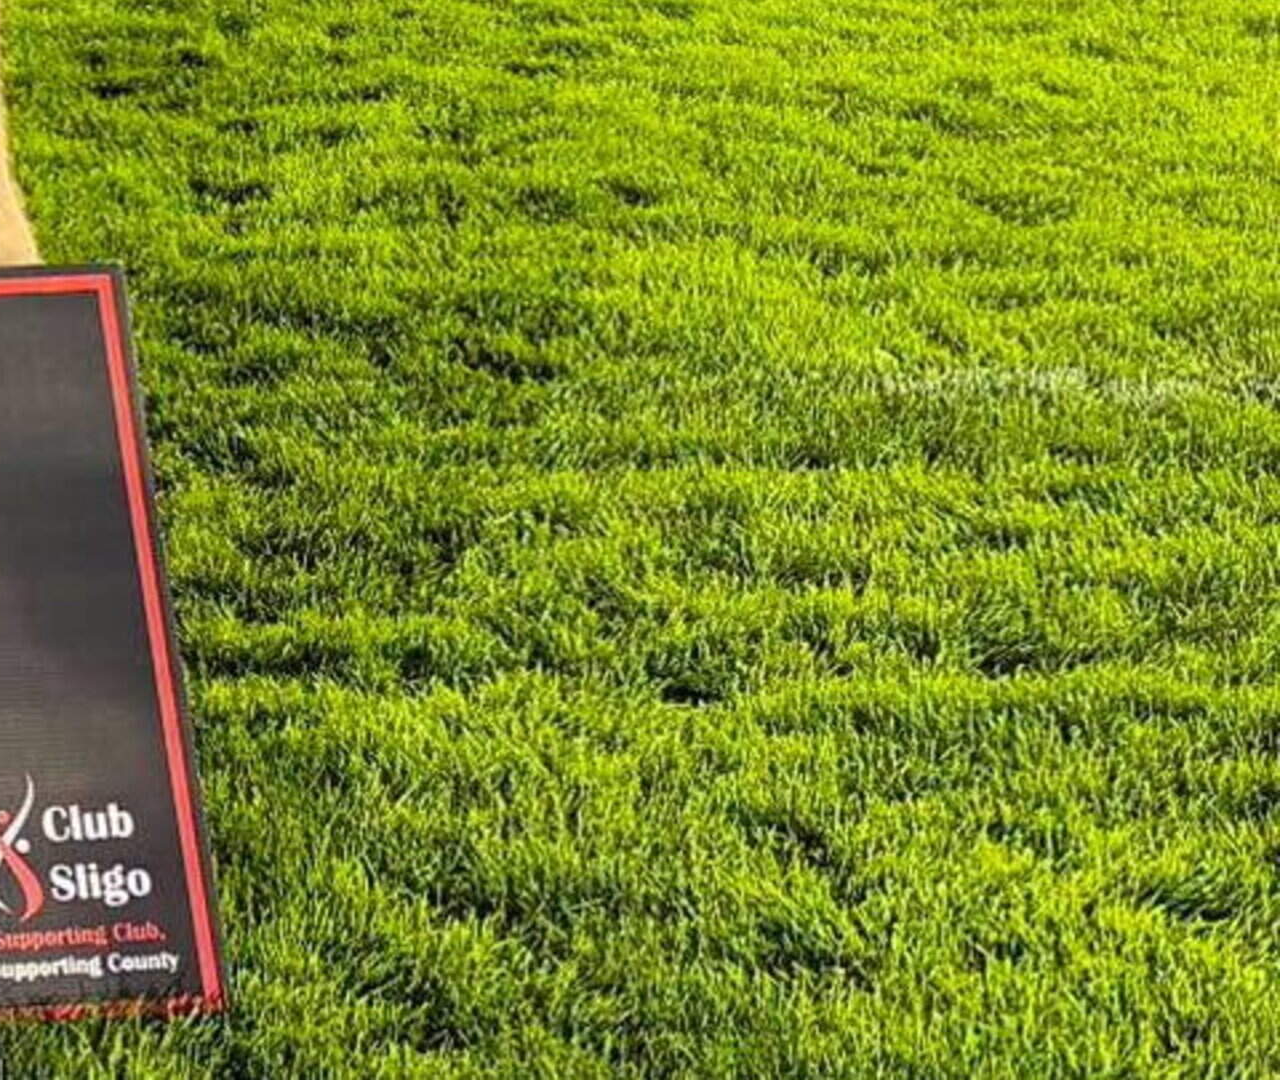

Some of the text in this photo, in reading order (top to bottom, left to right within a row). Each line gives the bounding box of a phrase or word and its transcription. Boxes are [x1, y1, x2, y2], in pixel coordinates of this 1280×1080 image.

[41, 802, 135, 843] Club
[48, 862, 152, 908] Sligo
[107, 951, 180, 975] County
